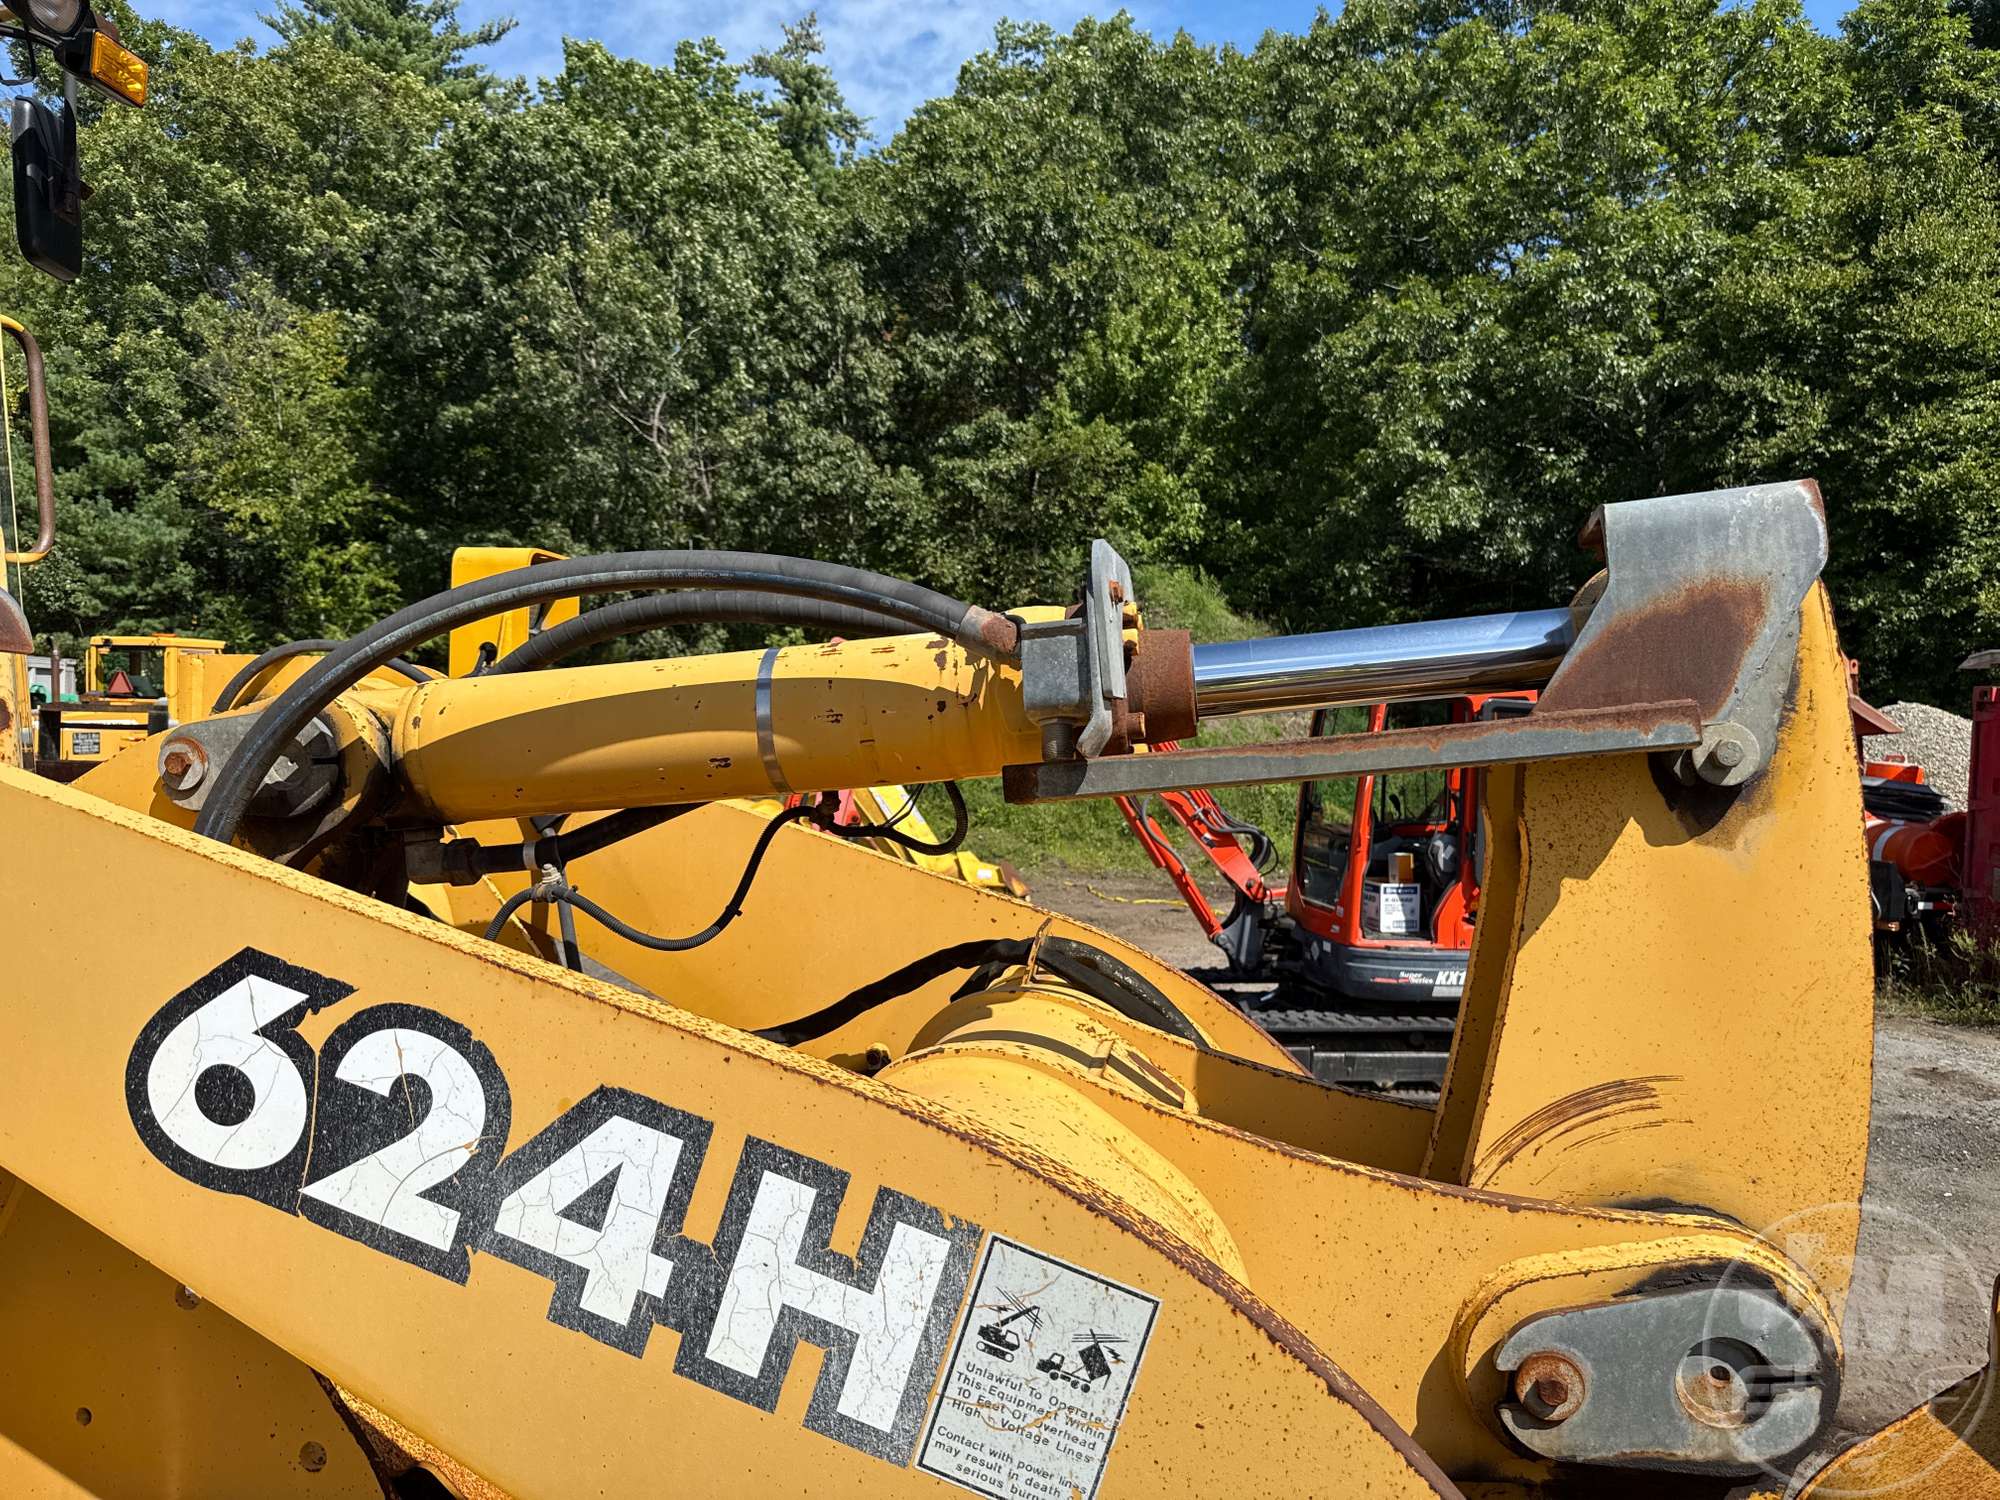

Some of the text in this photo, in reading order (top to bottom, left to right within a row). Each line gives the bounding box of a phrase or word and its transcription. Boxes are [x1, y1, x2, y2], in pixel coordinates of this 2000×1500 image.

[147, 974, 951, 1433] 624H
[957, 1386, 971, 1399] 10
[1012, 1409, 1028, 1422] Of
[957, 1371, 983, 1390] This
[1065, 1413, 1105, 1440] Within
[966, 1361, 1102, 1424] Unlawful To Operate
[937, 1425, 1087, 1494] Contact with power lines
[952, 1399, 1091, 1463] High Voltage Lines
[934, 1440, 1060, 1498] may result in death
[955, 1463, 1046, 1500] serious burn
